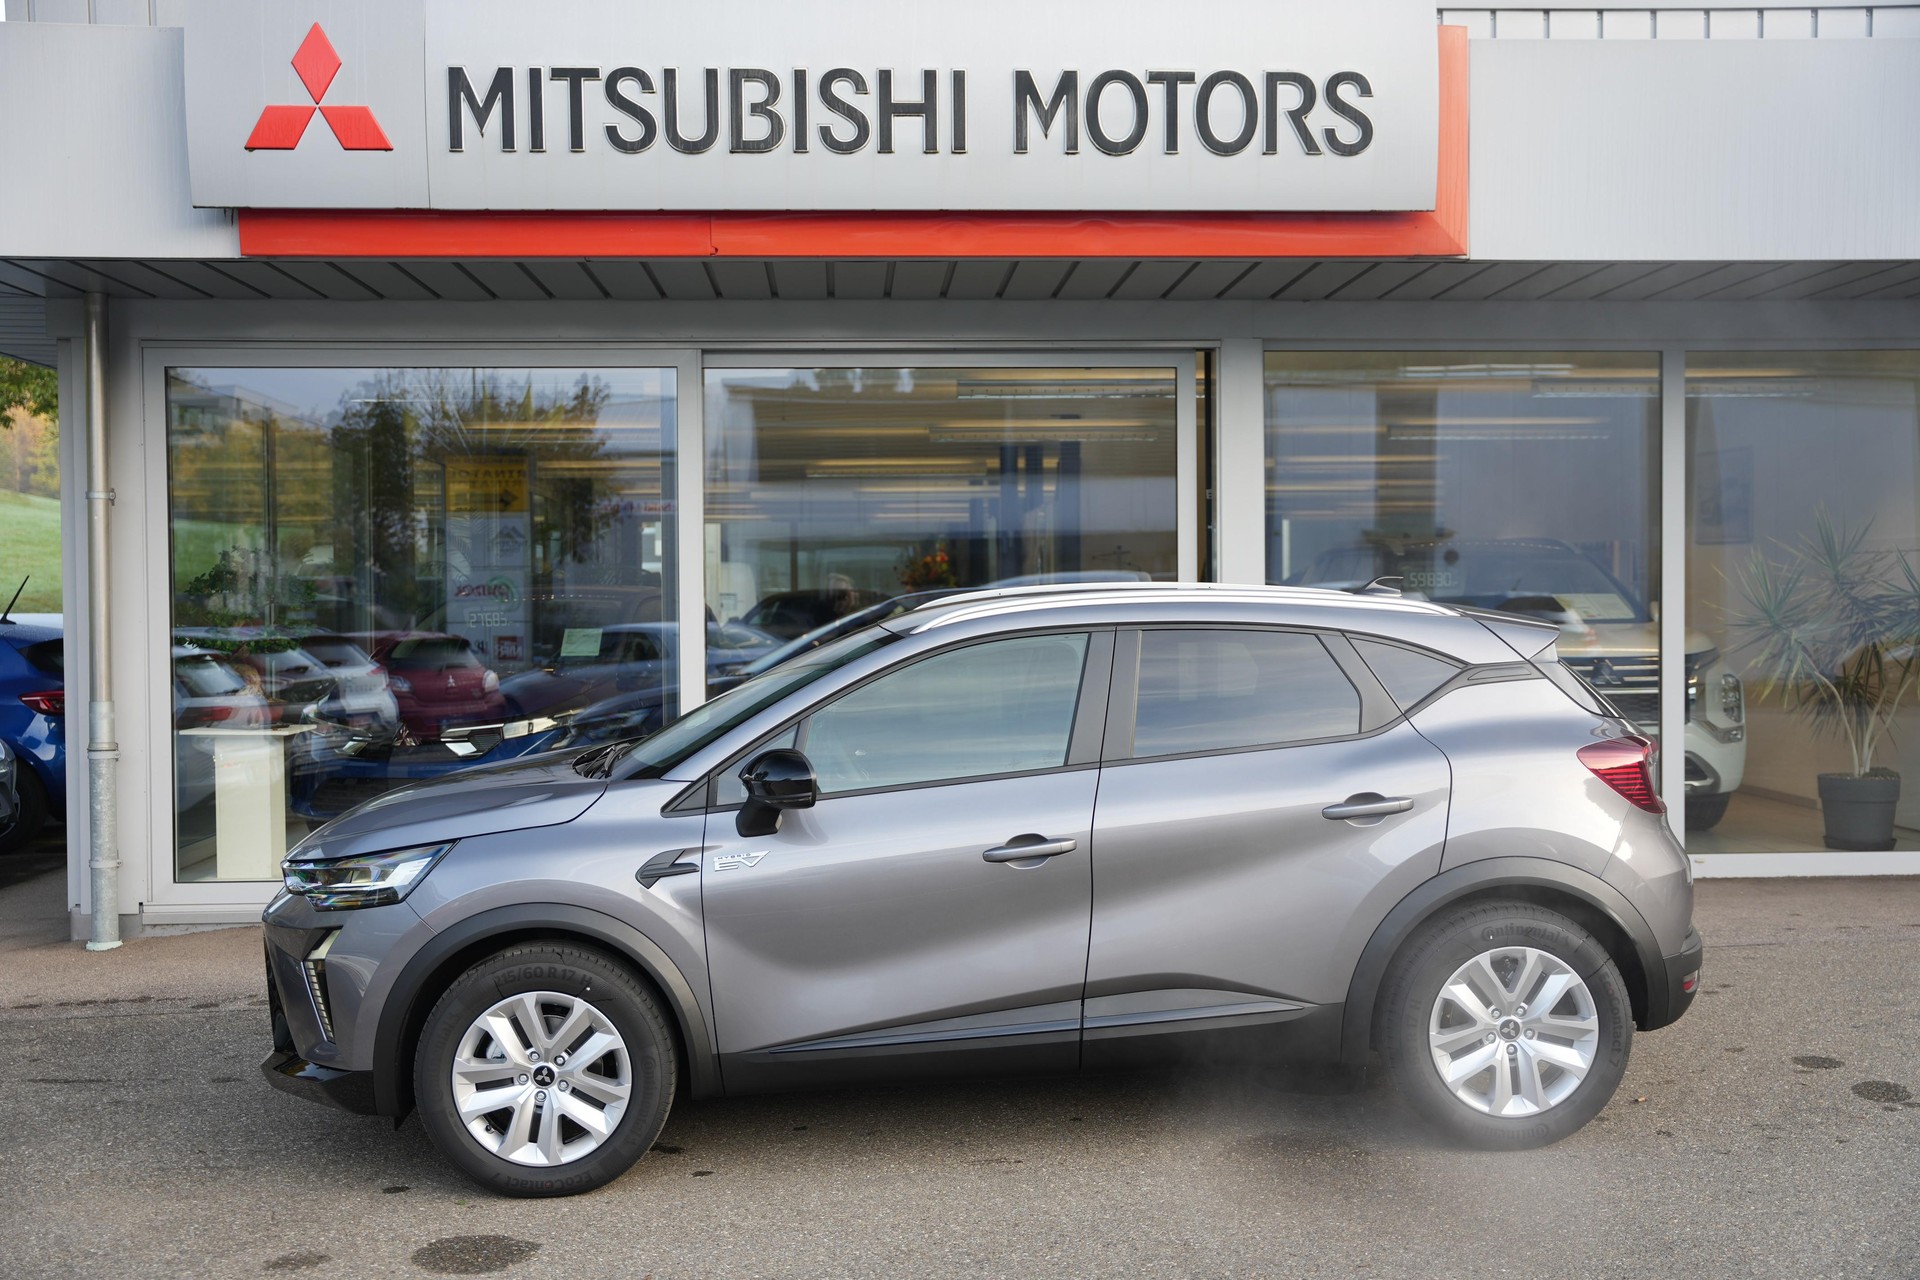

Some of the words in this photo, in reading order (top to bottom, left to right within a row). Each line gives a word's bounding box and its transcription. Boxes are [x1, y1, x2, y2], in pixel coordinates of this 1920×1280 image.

[446, 65, 969, 155] MITSUBISHI
[1012, 68, 1375, 157] MOTORS
[714, 850, 771, 872] EV
[548, 966, 558, 979] R
[560, 968, 577, 981] 17
